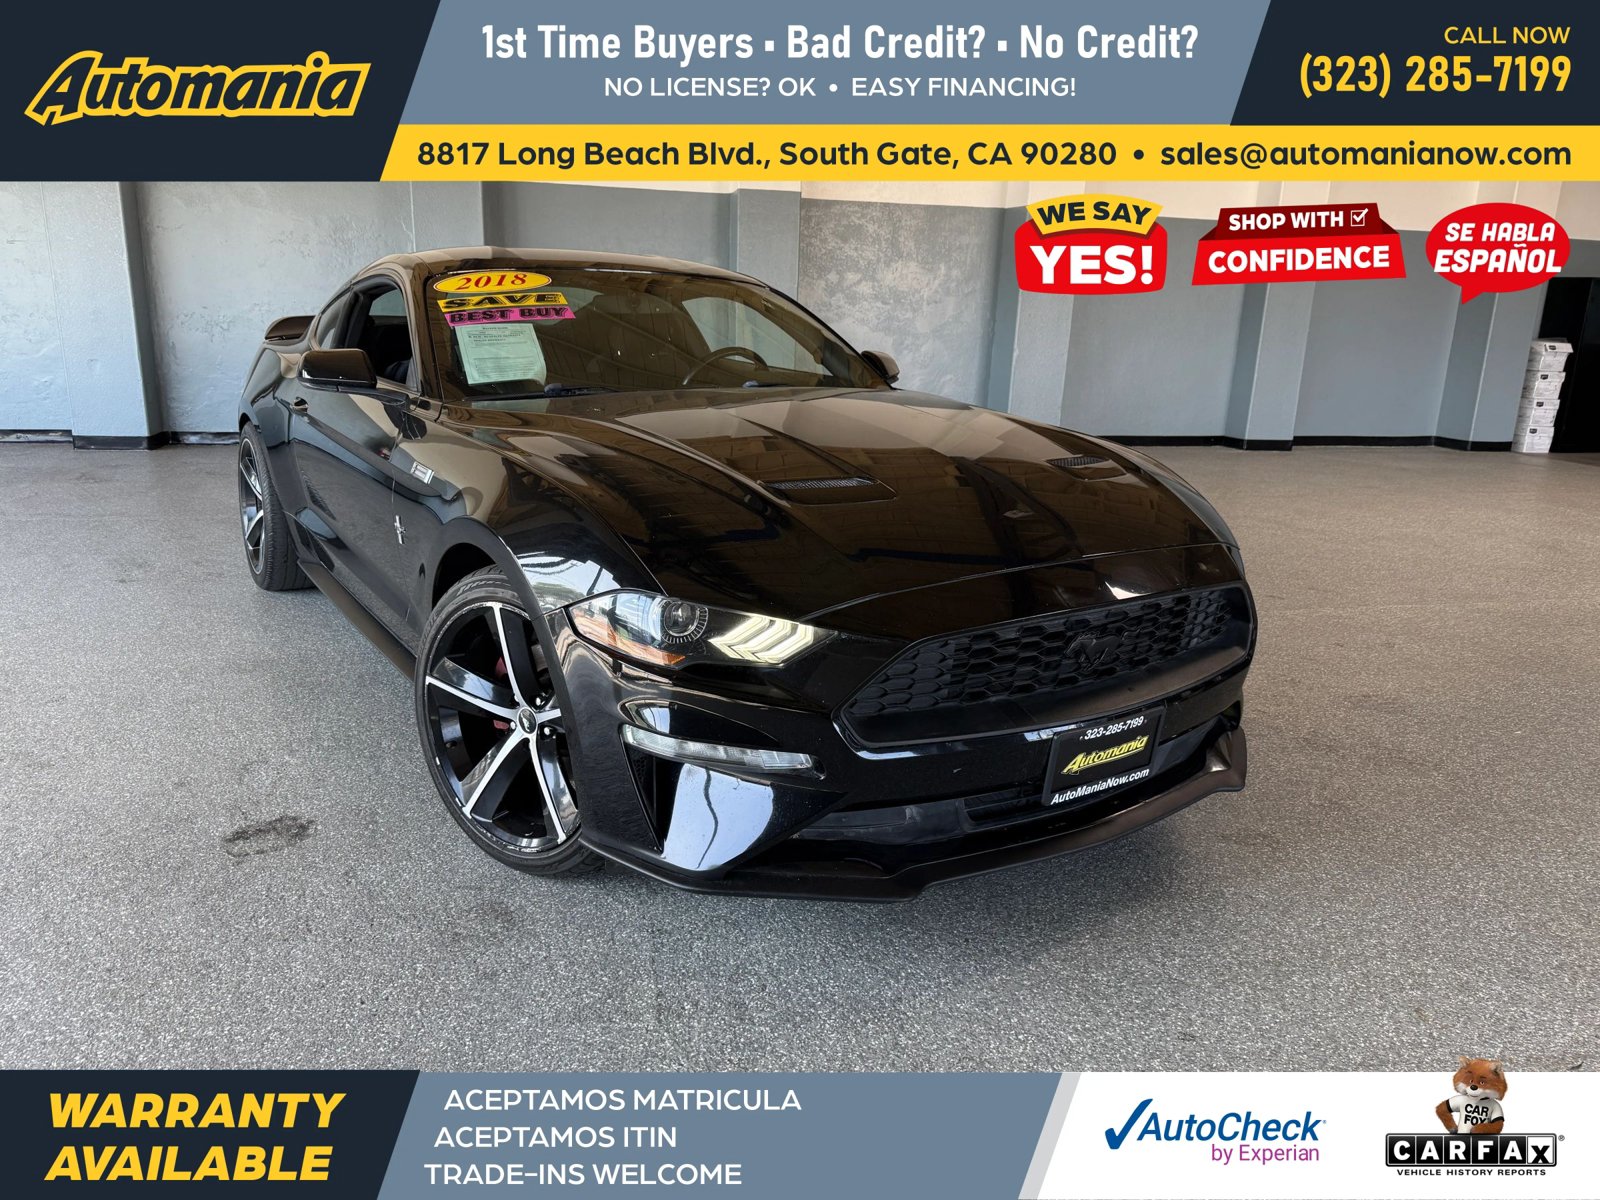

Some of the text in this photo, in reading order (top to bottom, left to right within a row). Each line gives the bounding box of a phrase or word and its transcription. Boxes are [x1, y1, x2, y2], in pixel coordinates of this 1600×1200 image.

[456, 274, 528, 290] 2018
[446, 294, 562, 309] SAVE
[449, 307, 568, 323] BEST BUY
[1083, 716, 1144, 740] 323-285-7199
[1061, 735, 1150, 775] Automania
[1050, 768, 1150, 806] AutoManiaNow.com
